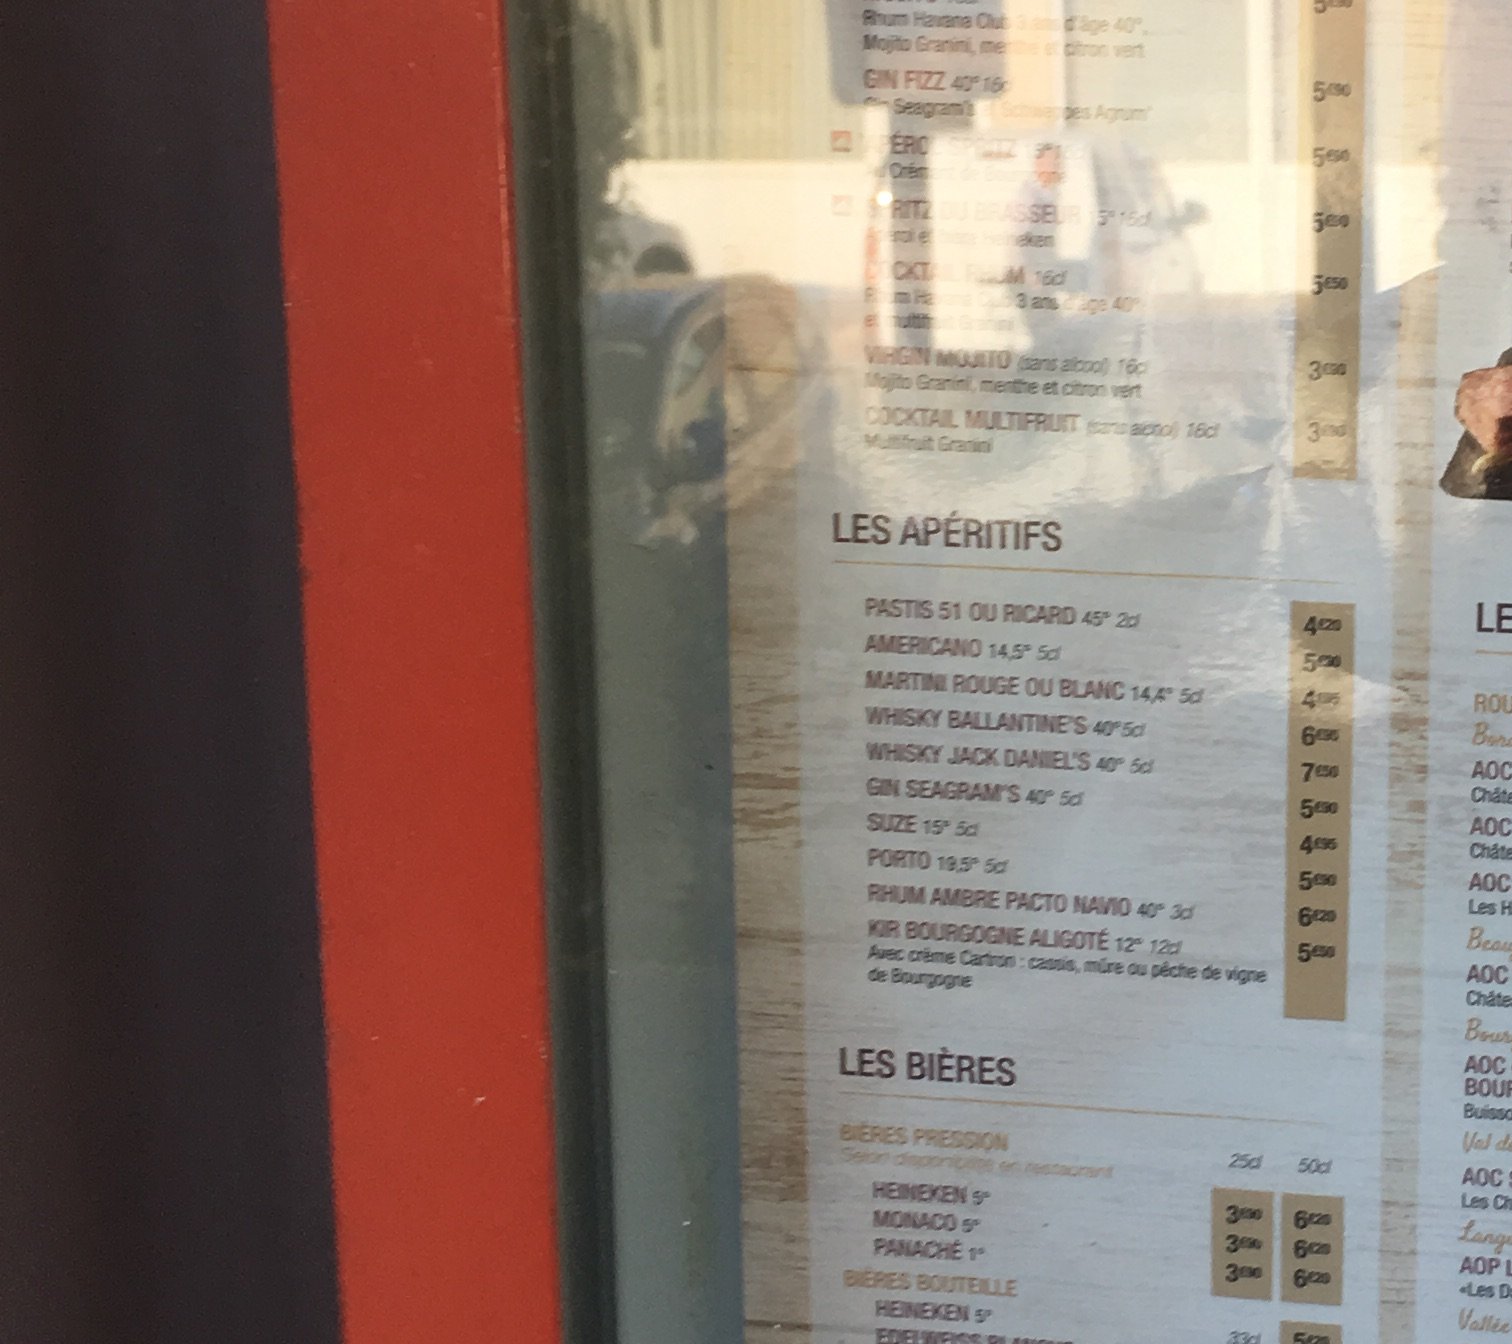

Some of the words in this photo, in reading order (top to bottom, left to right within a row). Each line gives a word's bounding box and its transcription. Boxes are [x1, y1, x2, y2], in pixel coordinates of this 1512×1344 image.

[832, 513, 891, 545] LES
[899, 511, 1062, 552] APÉRITIFS
[866, 598, 934, 620] PASTIS
[939, 602, 963, 620] 51
[970, 602, 998, 622] OU
[1004, 602, 1076, 625] RICARD
[839, 1048, 896, 1079] LES
[907, 1047, 1017, 1086] BIÈRES
[1463, 1167, 1504, 1188] AOC
[1460, 1256, 1500, 1277] AOP
